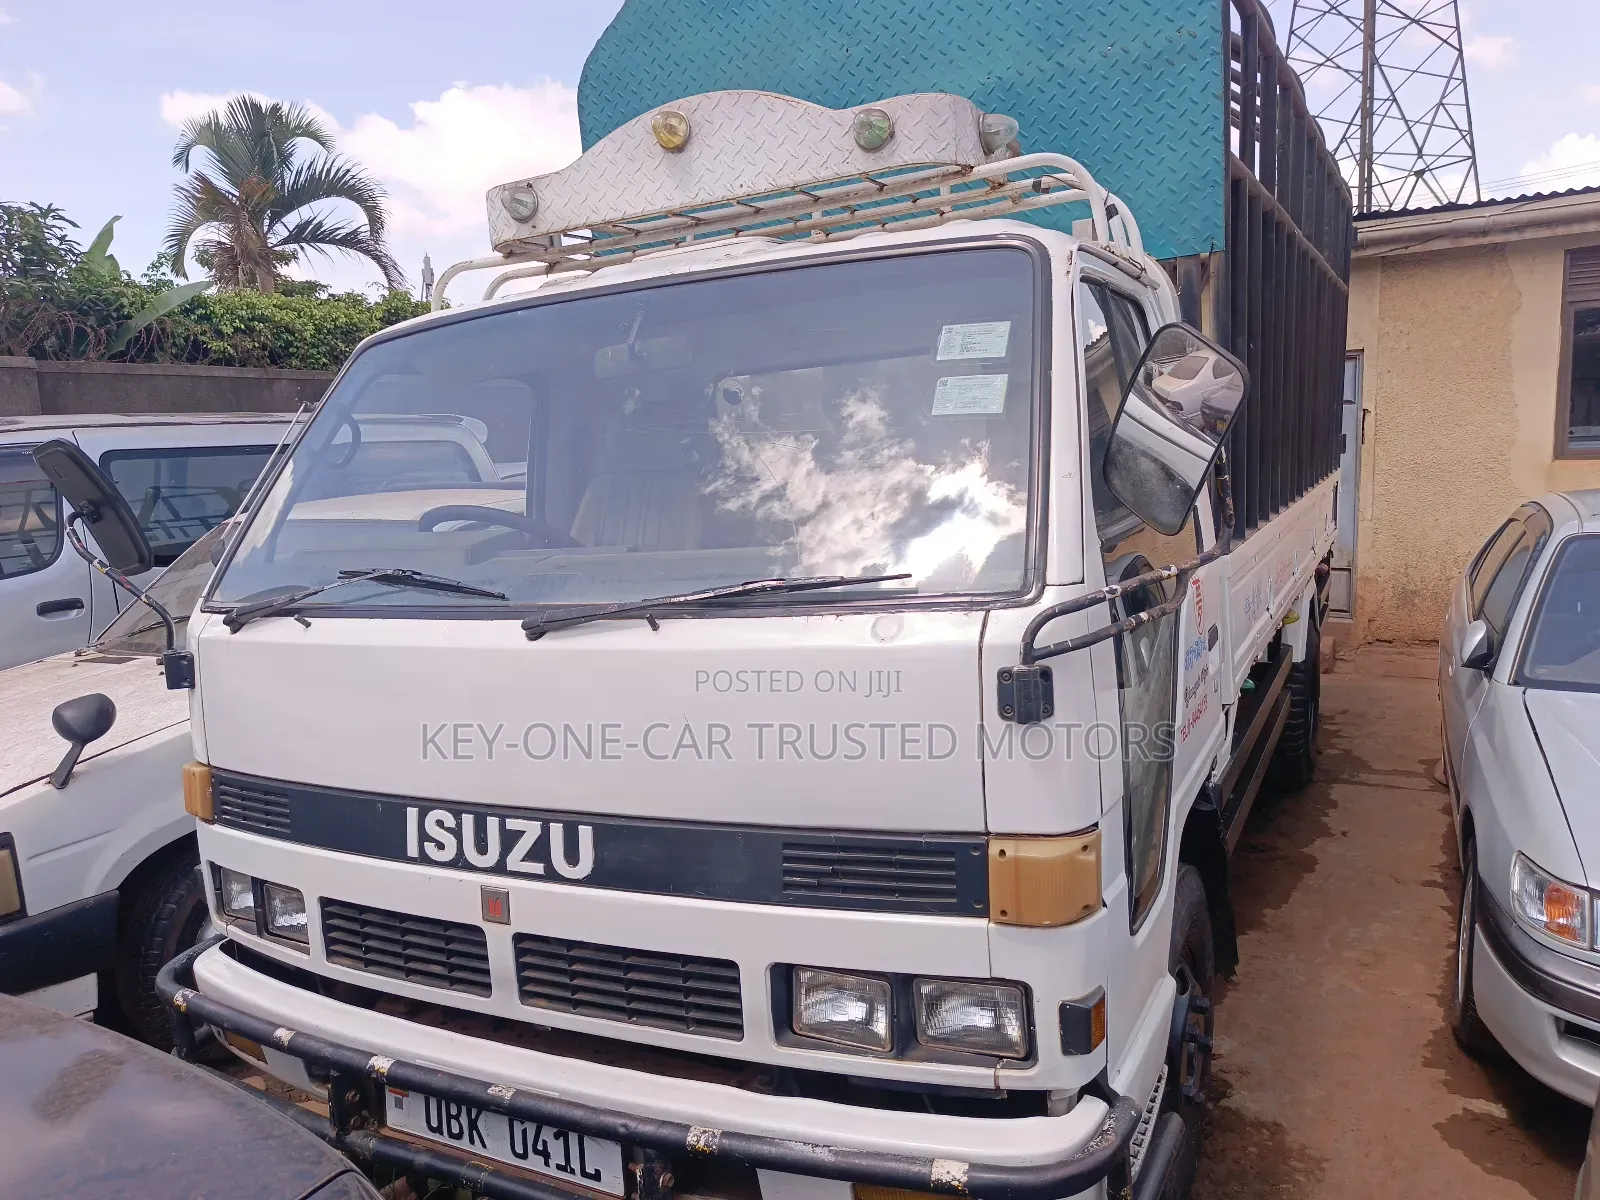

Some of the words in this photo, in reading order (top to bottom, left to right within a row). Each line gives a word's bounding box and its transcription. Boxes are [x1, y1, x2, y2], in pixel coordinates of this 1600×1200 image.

[406, 806, 595, 880] ISUZU
[423, 1094, 488, 1150] UBK
[508, 1116, 602, 1183] 041L
